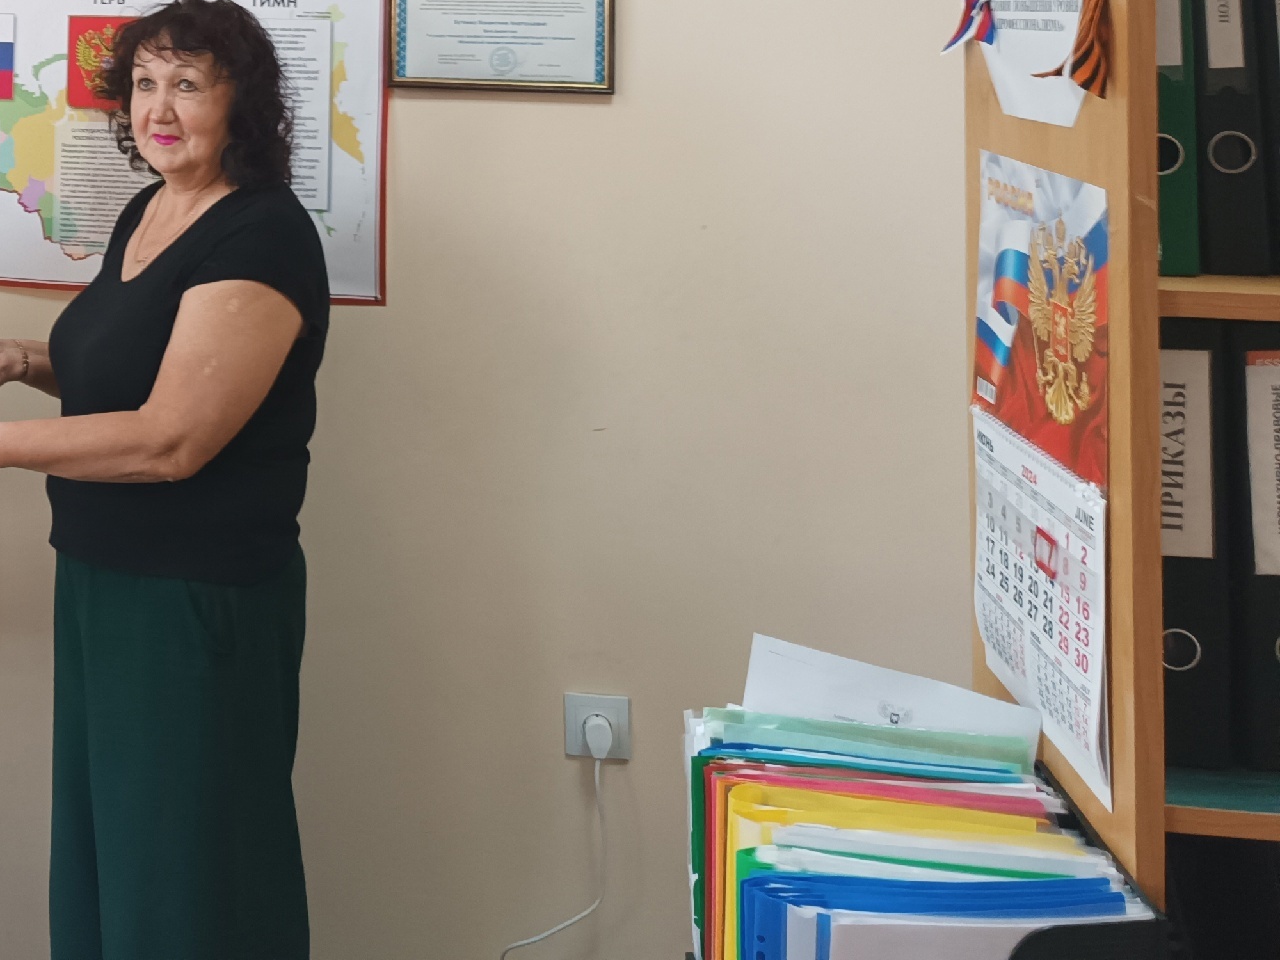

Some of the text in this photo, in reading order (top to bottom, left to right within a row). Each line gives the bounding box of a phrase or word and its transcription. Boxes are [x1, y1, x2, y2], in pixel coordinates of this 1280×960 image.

[1021, 464, 1037, 485] 2024
[1159, 381, 1186, 531] ПРИКАЗЫ
[985, 513, 995, 533] 10
[999, 525, 1008, 546] 11
[1076, 595, 1090, 620] 16
[1001, 505, 1007, 519] 4
[1080, 572, 1087, 590] 9
[1064, 532, 1070, 550] 1
[1081, 546, 1088, 566] 2
[1075, 506, 1095, 531] JUNE
[985, 535, 995, 556] 17
[999, 549, 1009, 570] 18
[1013, 562, 1023, 584] 19
[1028, 575, 1038, 598] 20
[1043, 590, 1053, 614] 21
[1059, 604, 1069, 630] 22
[1075, 621, 1090, 647] 23
[985, 557, 996, 579] 24
[999, 571, 1009, 593] 25
[1013, 585, 1023, 608] 26
[1027, 599, 1038, 622] 27
[1042, 615, 1053, 639] 28
[1058, 630, 1069, 656] 29
[1074, 647, 1089, 674] 30
